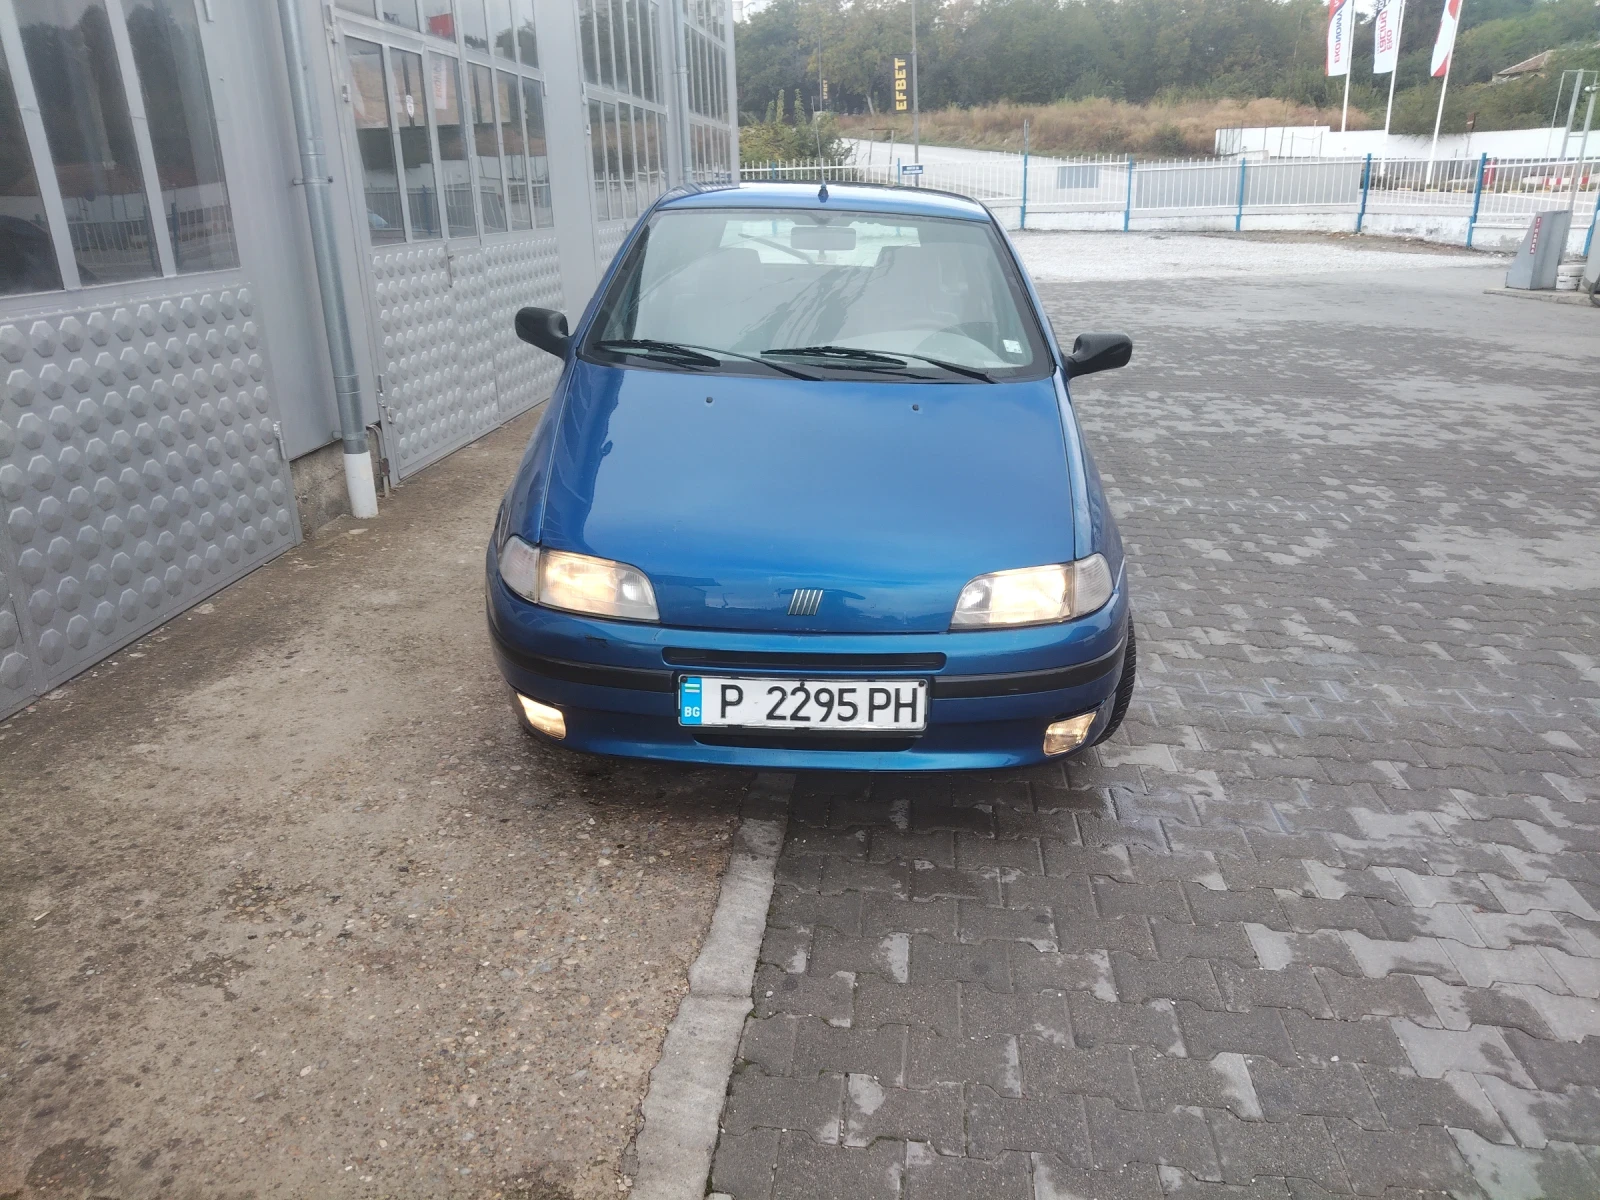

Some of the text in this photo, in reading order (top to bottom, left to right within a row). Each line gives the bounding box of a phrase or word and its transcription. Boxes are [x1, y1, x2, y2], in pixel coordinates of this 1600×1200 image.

[894, 57, 907, 111] EFBET
[684, 706, 700, 717] BG
[766, 686, 858, 722] 2295
